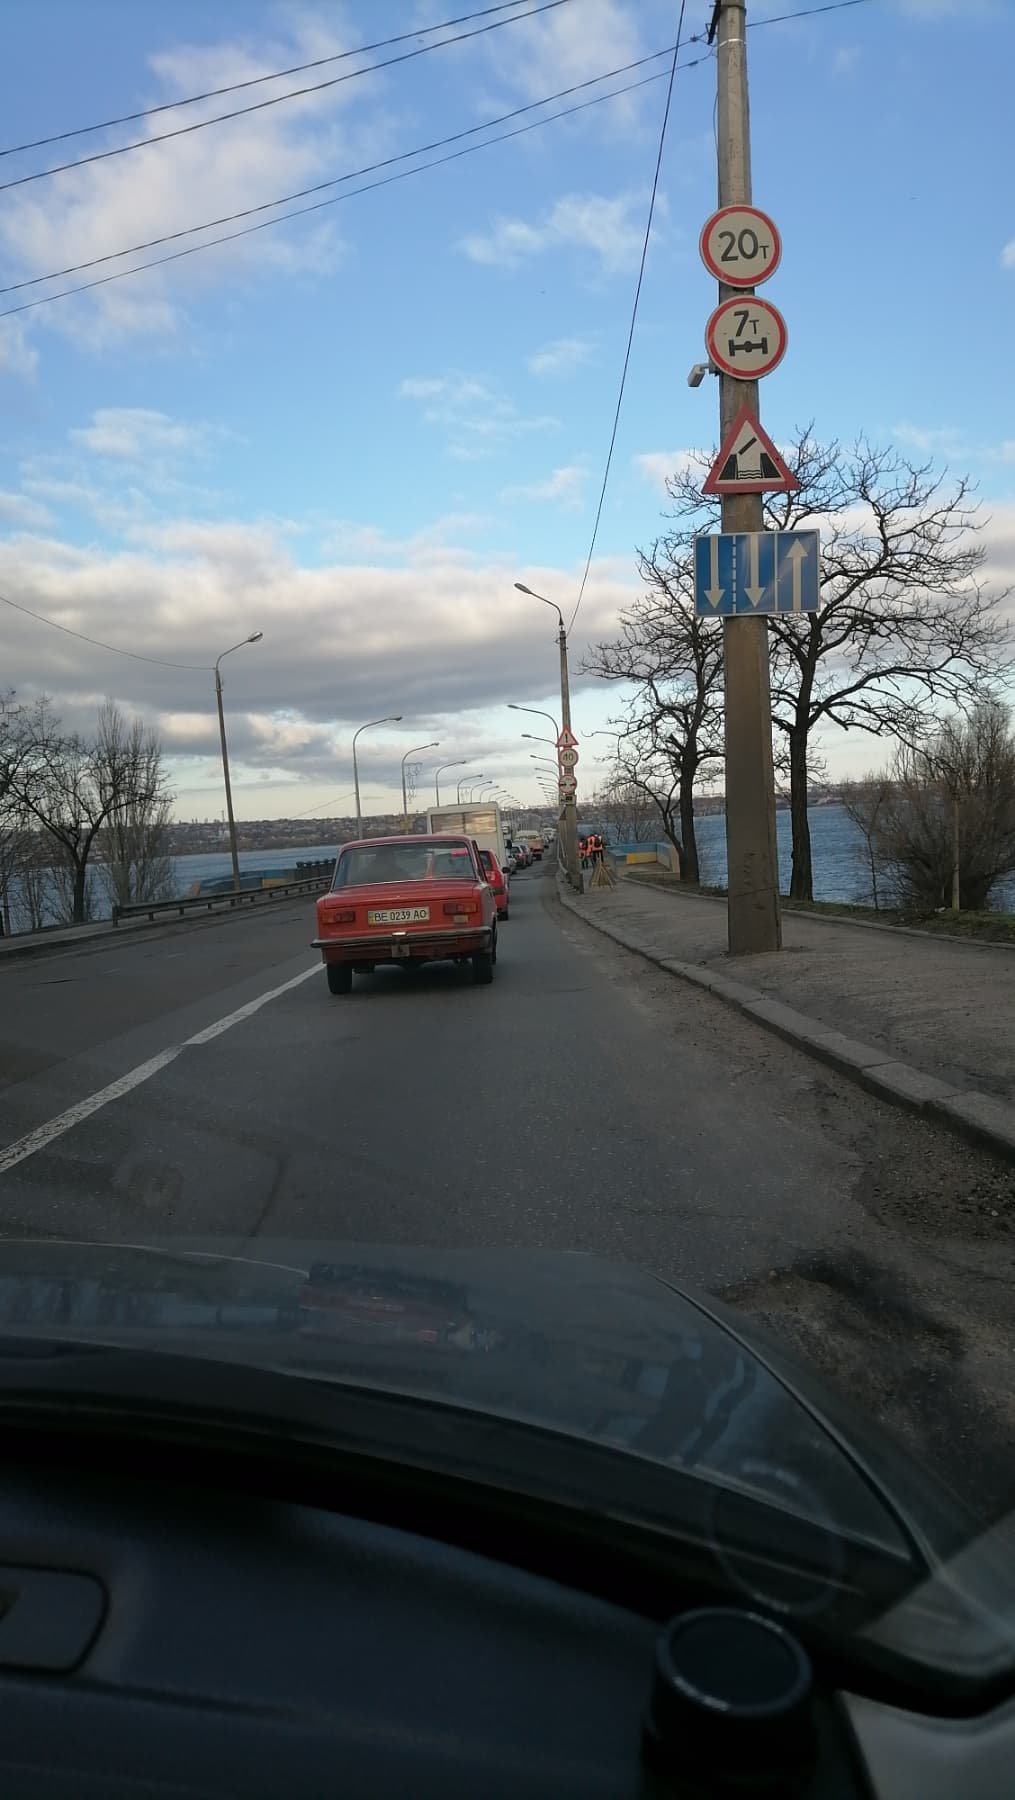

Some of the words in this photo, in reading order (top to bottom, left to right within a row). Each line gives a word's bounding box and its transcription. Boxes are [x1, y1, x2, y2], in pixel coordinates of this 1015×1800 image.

[374, 912, 388, 922] BE
[390, 910, 411, 921] 0239
[413, 909, 427, 920] AO
